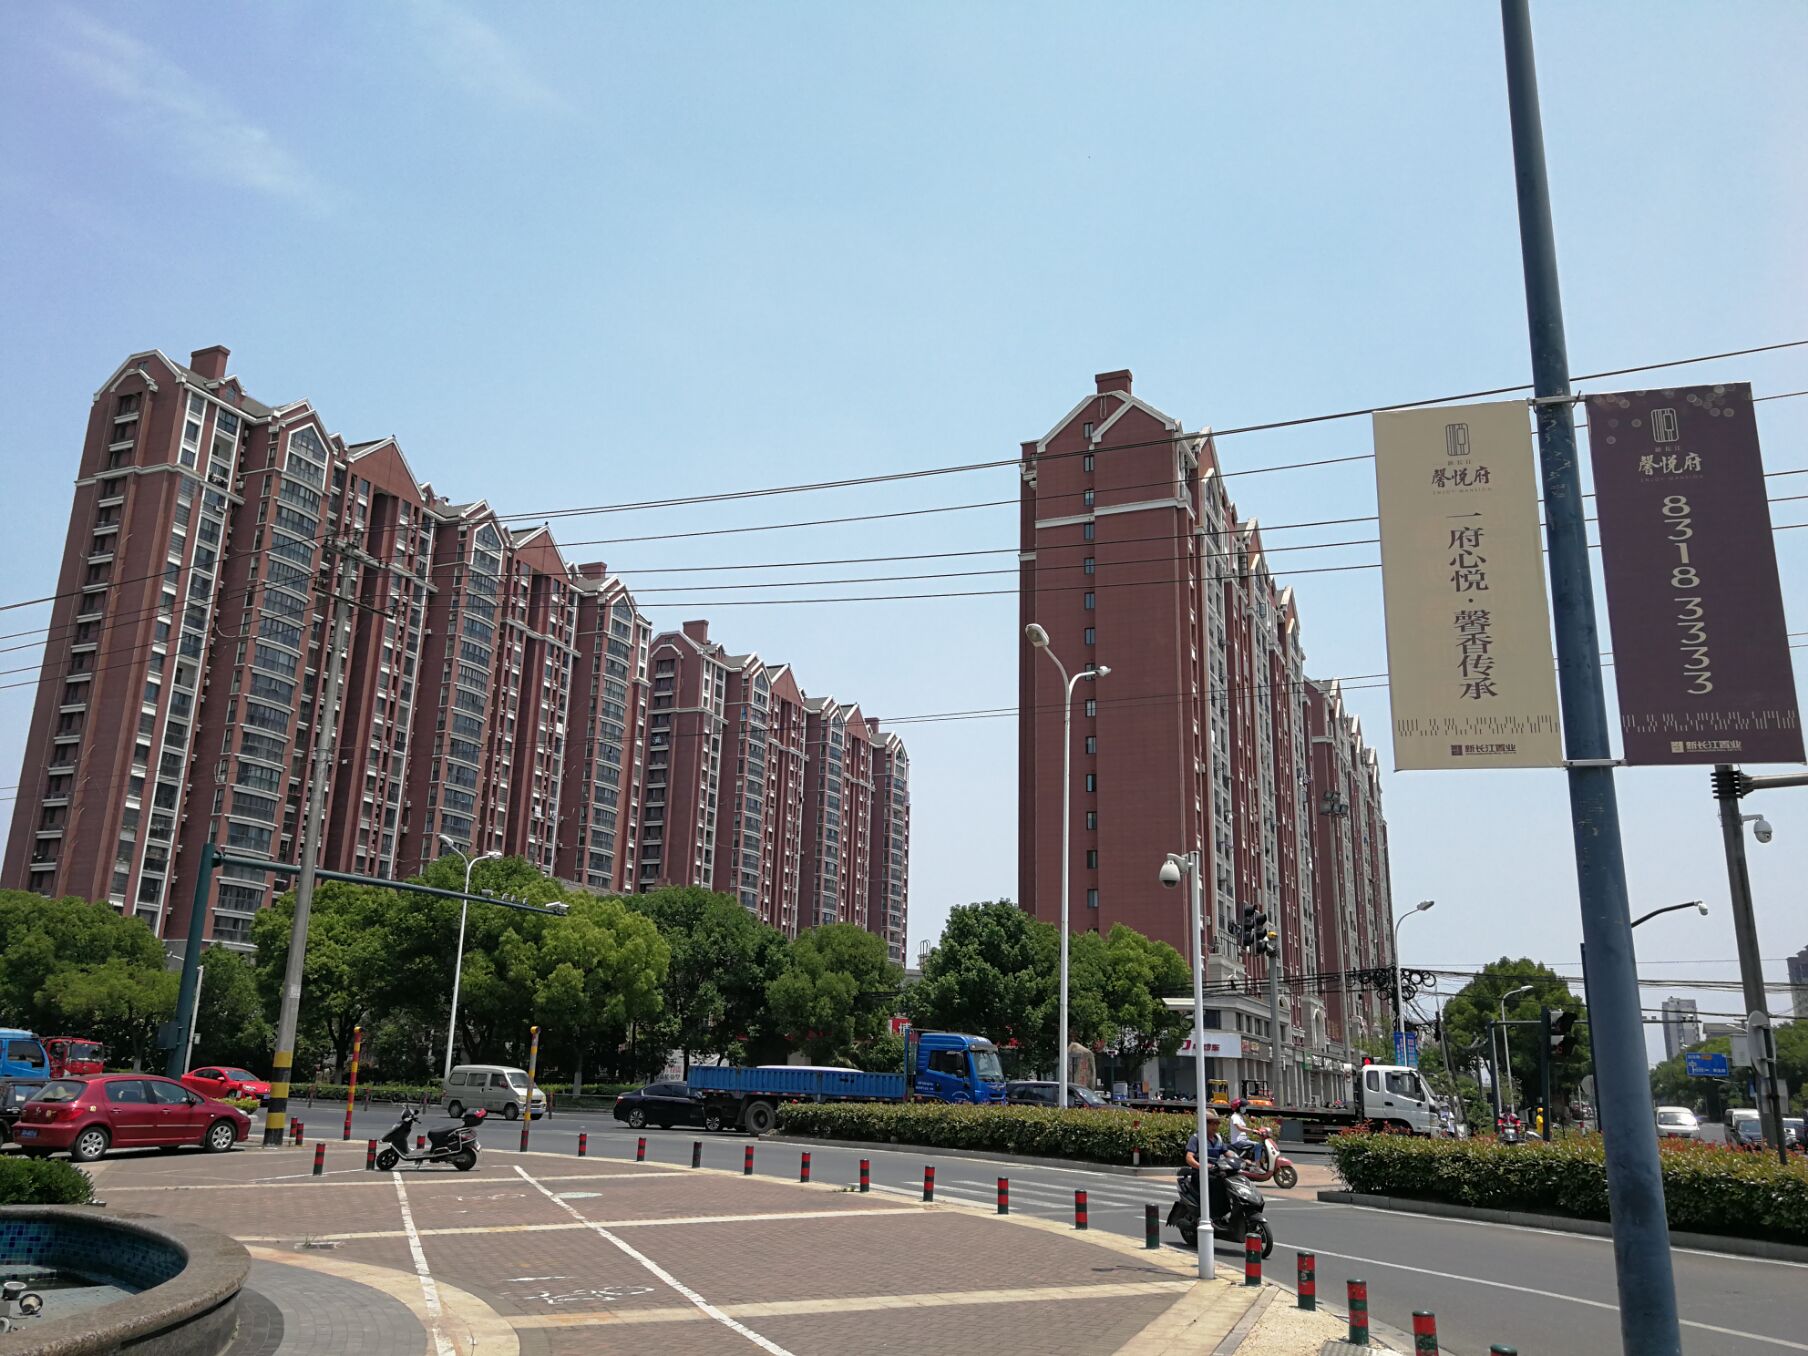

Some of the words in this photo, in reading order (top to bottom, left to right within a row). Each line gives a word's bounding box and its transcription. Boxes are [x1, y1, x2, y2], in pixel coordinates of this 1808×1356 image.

[1639, 452, 1702, 475] 馨悦府
[1431, 465, 1491, 487] 馨悦府
